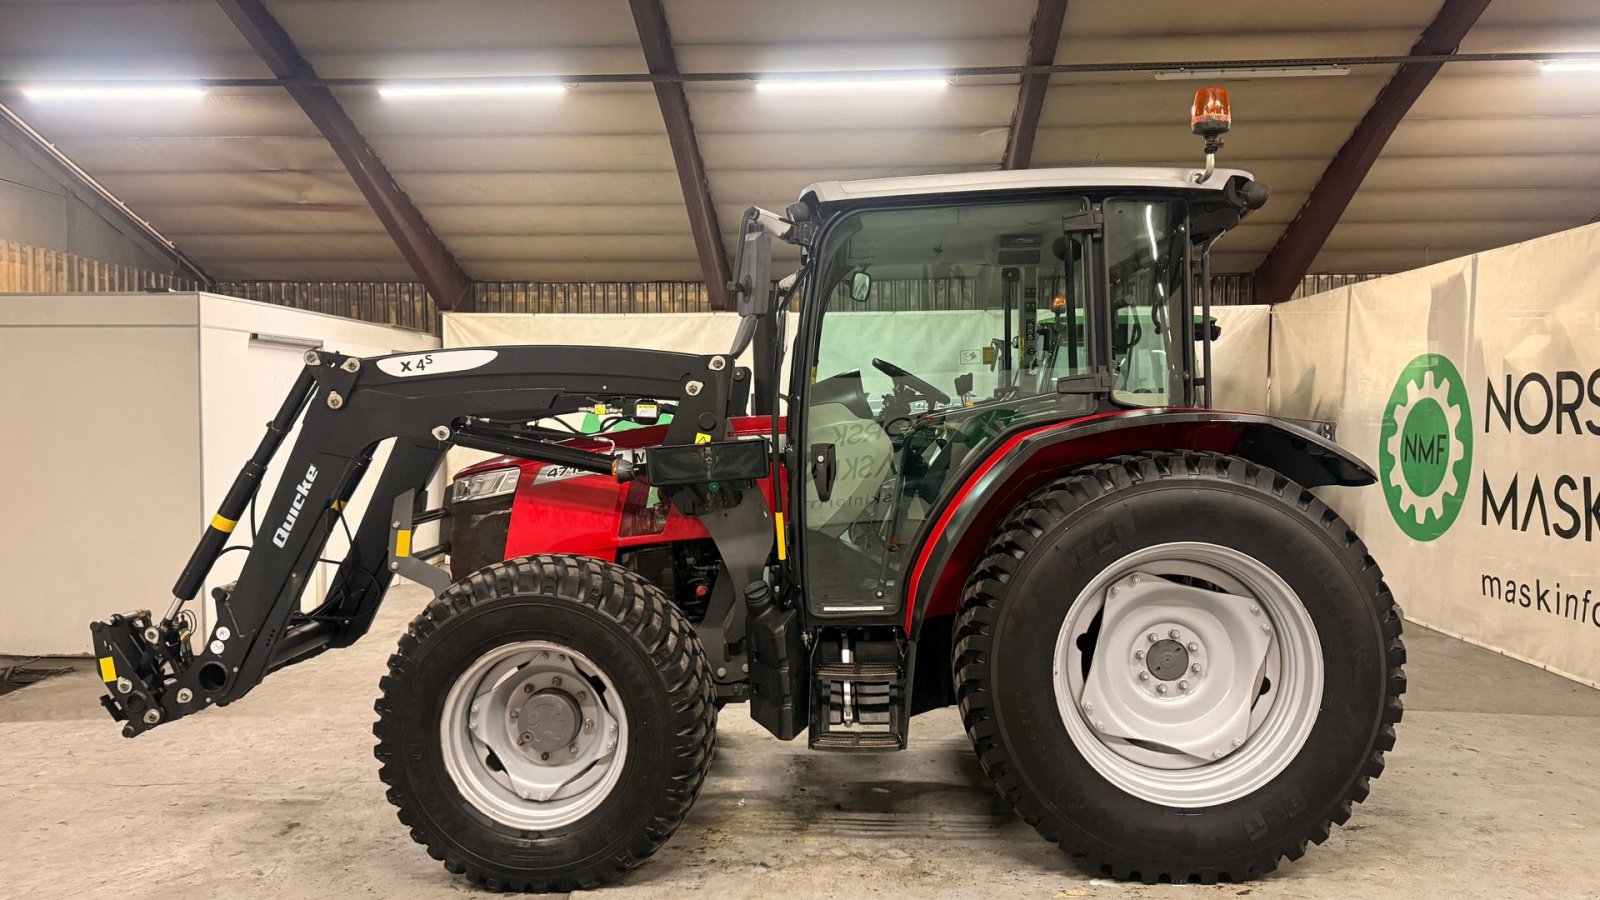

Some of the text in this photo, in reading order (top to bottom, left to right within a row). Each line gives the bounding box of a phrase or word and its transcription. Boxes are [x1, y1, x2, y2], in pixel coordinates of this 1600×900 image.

[1404, 433, 1447, 466] NMF
[273, 463, 319, 549] Quicke
[1481, 469, 1600, 543] MASK
